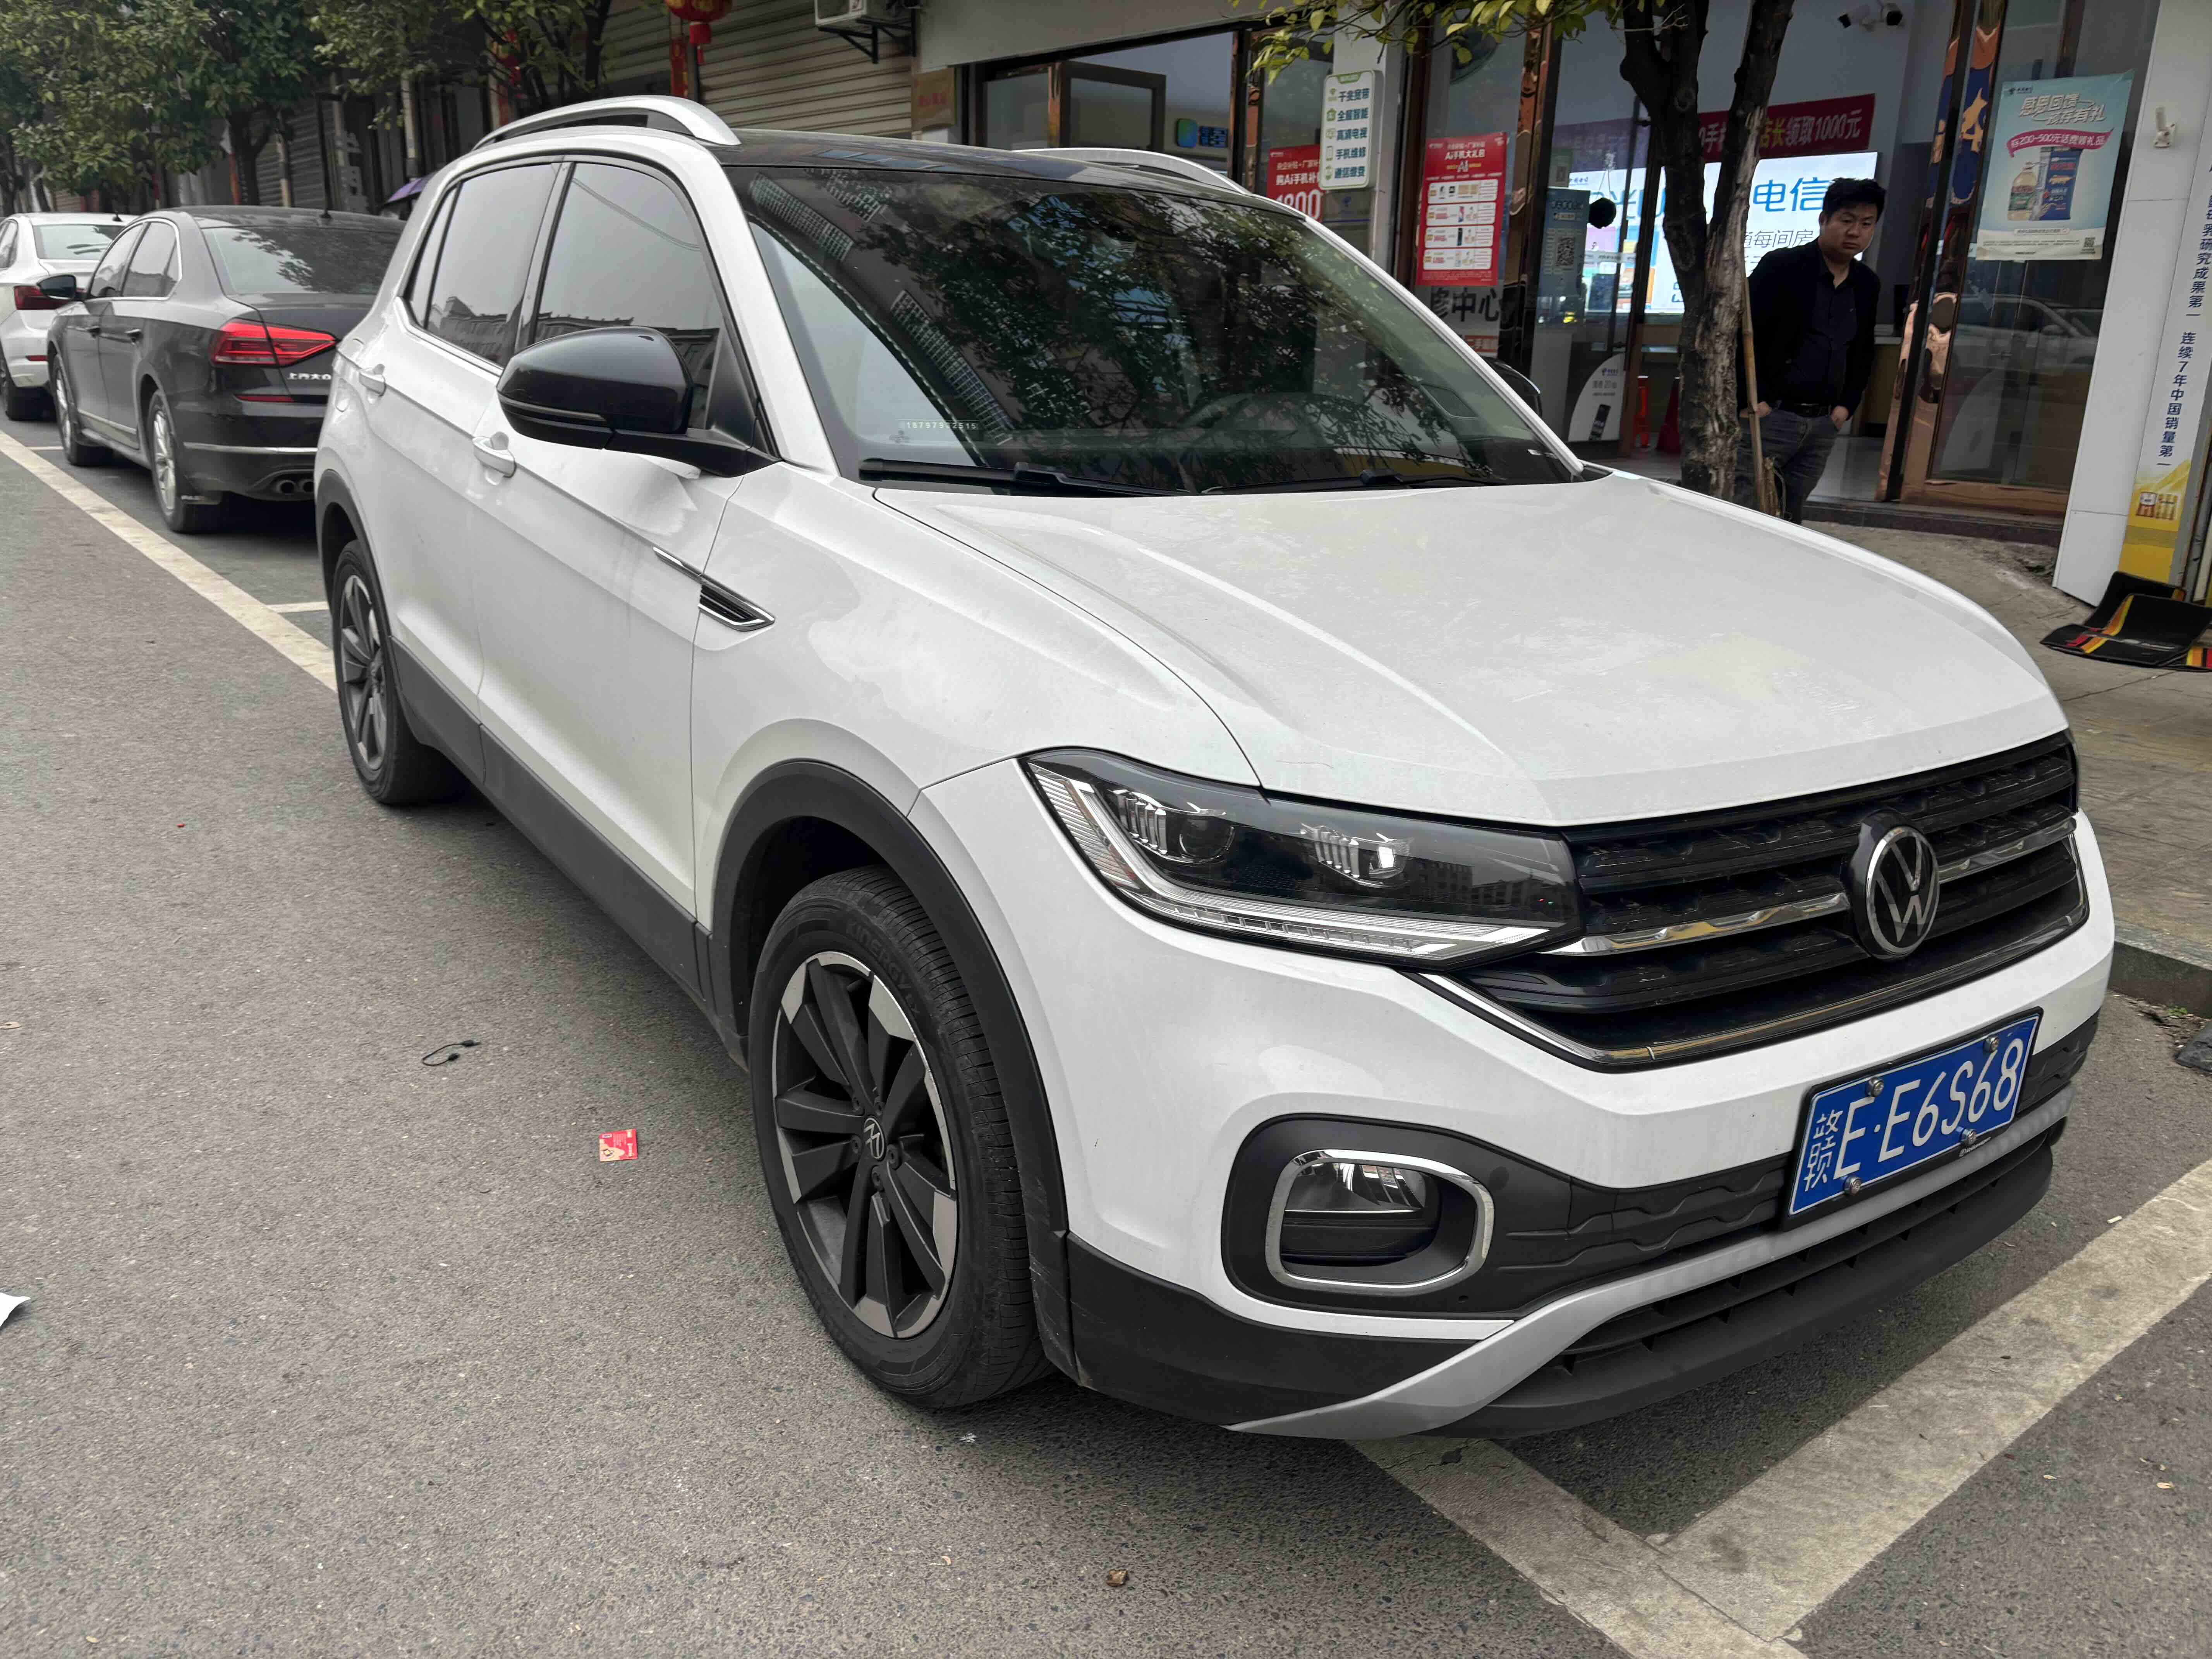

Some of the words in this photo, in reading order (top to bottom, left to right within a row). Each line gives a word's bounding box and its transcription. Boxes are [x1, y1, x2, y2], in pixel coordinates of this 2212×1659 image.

[1753, 177, 1829, 212] 电信
[2156, 331, 2197, 466] 连续7年中国销量第一
